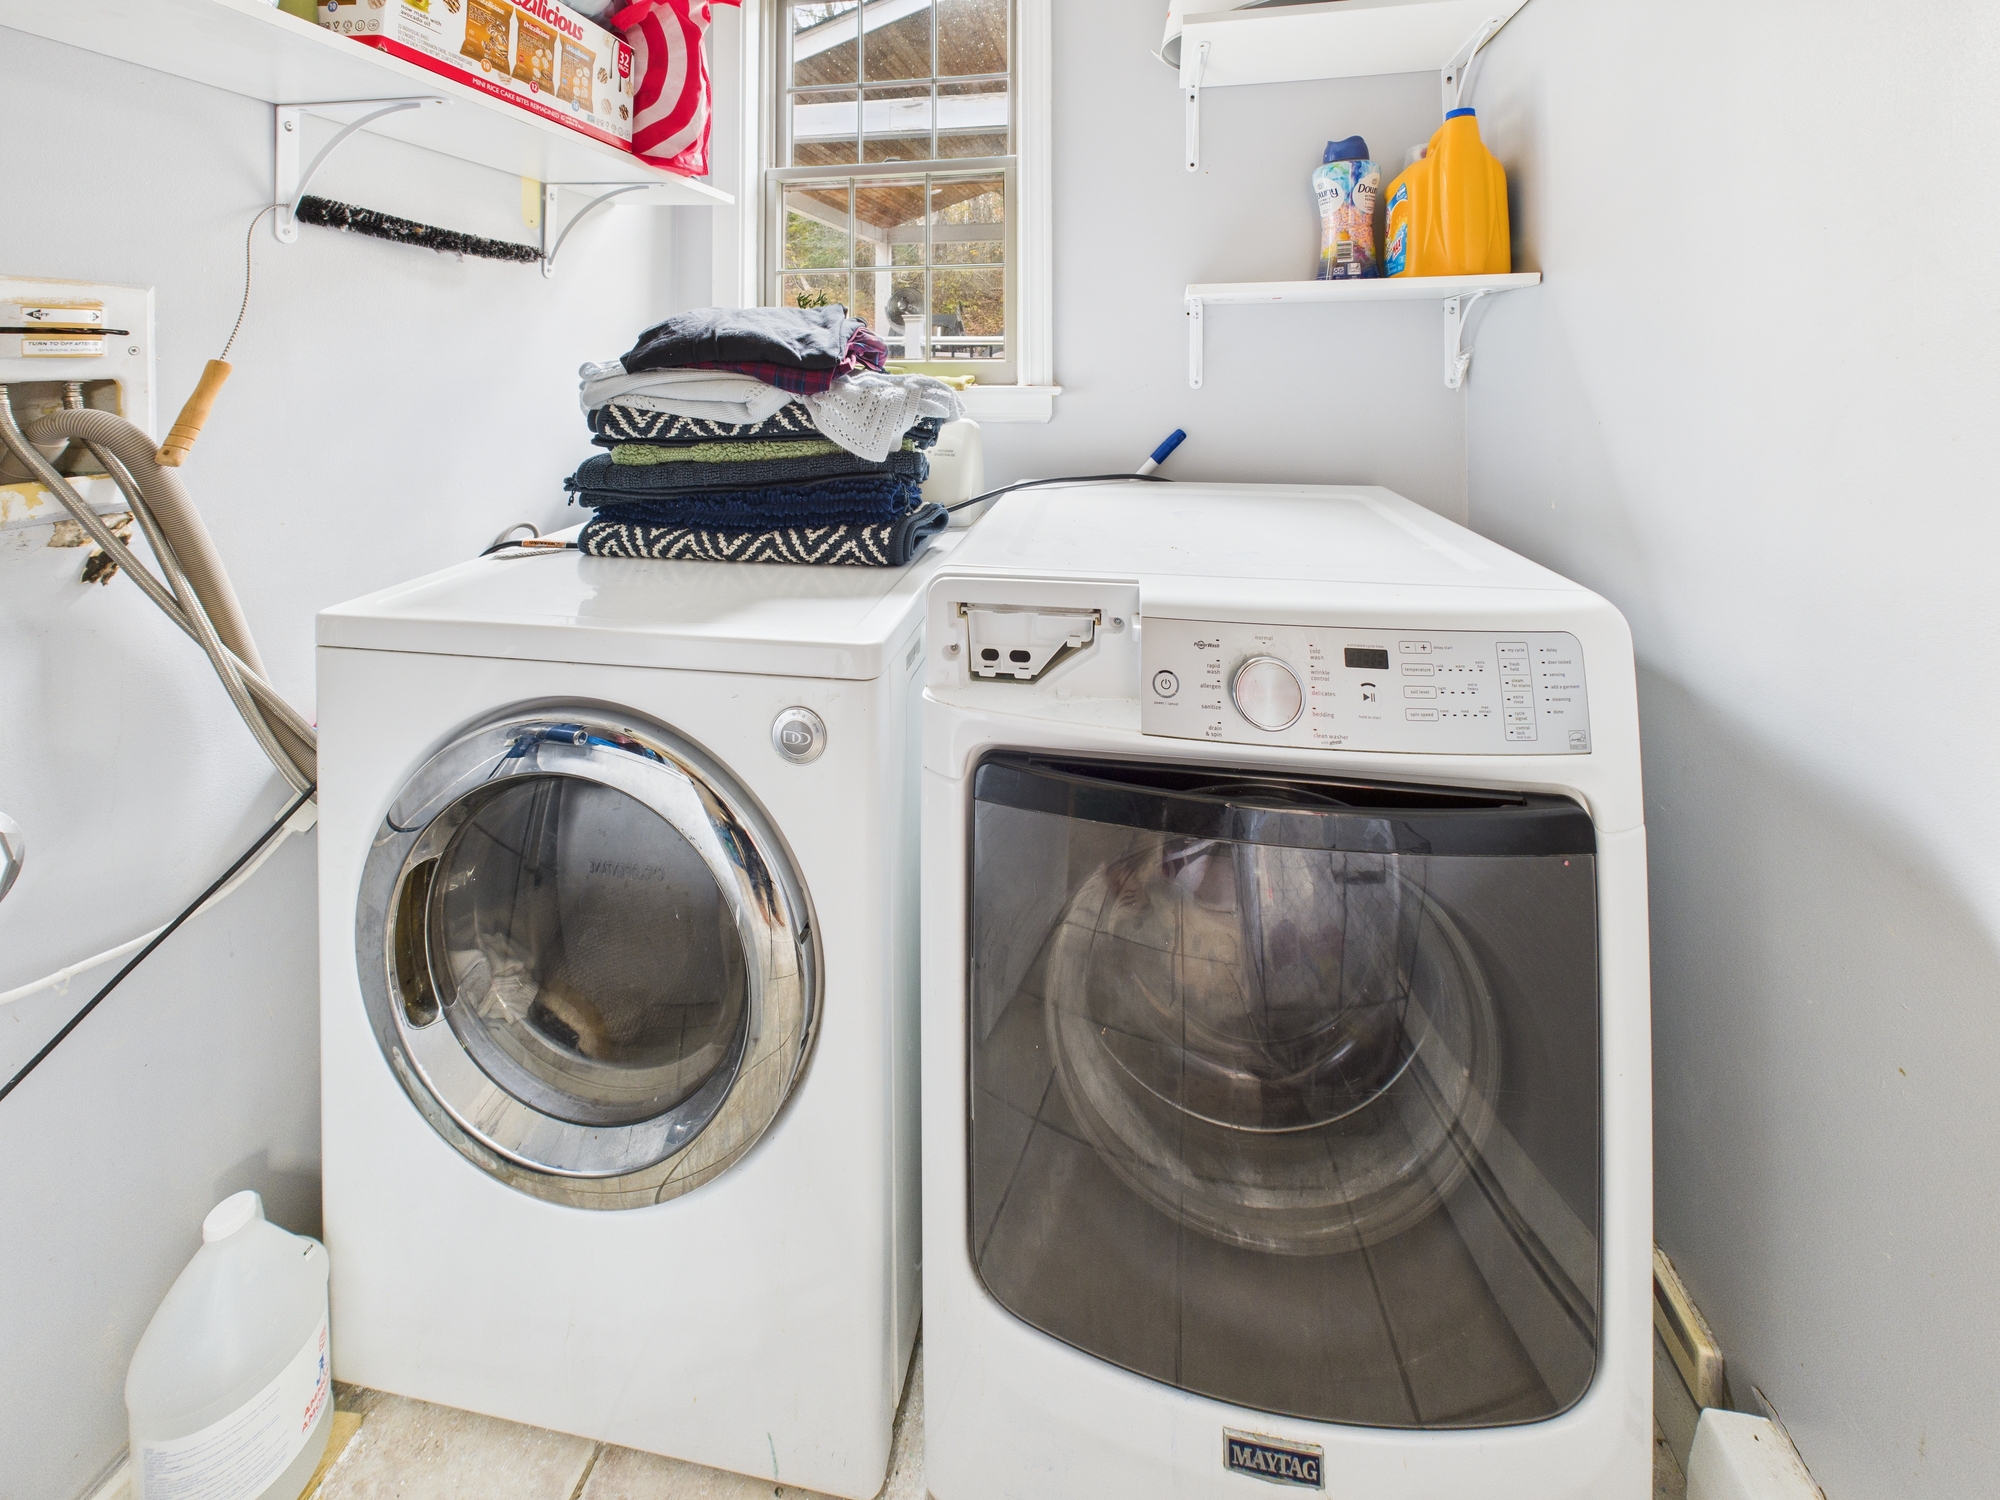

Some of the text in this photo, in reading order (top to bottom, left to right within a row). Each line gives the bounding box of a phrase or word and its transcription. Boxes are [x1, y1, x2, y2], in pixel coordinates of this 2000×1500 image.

[400, 4, 442, 27] now made with
[400, 9, 423, 23] avocado
[619, 50, 630, 67] 32
[482, 61, 490, 70] 10
[618, 63, 630, 74] PACK
[531, 83, 538, 92] 12
[472, 77, 559, 118] MINI RICE CAKE BITES REIMAGINED
[1317, 187, 1339, 199] owny
[1358, 183, 1377, 194] Down
[1231, 1444, 1318, 1481] MAYTAG
